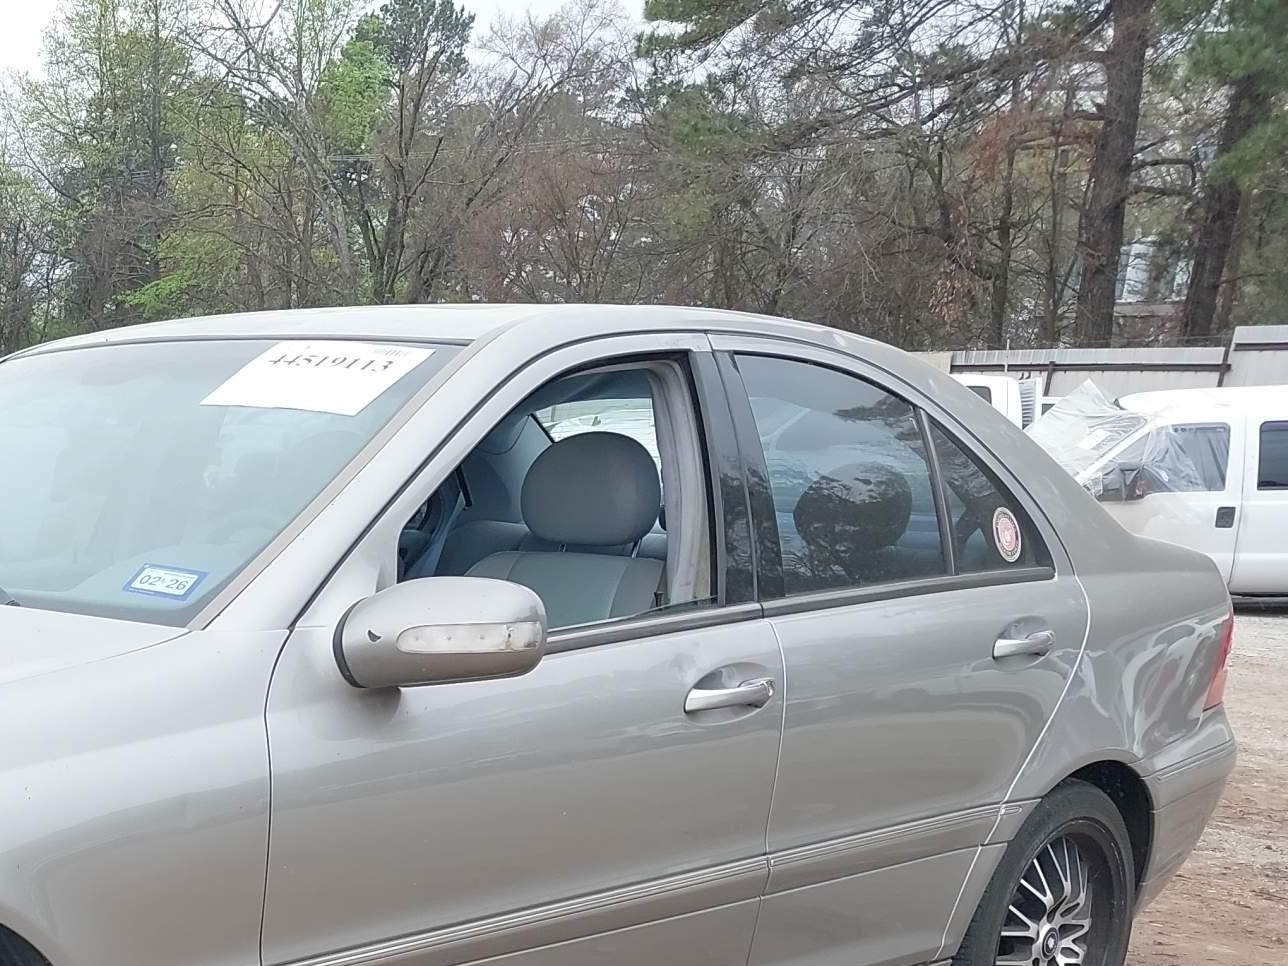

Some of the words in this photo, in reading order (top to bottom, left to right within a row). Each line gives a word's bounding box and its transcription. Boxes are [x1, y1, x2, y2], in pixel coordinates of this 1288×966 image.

[268, 353, 395, 373] 44519113
[138, 574, 162, 586] 02
[165, 578, 190, 591] 26
